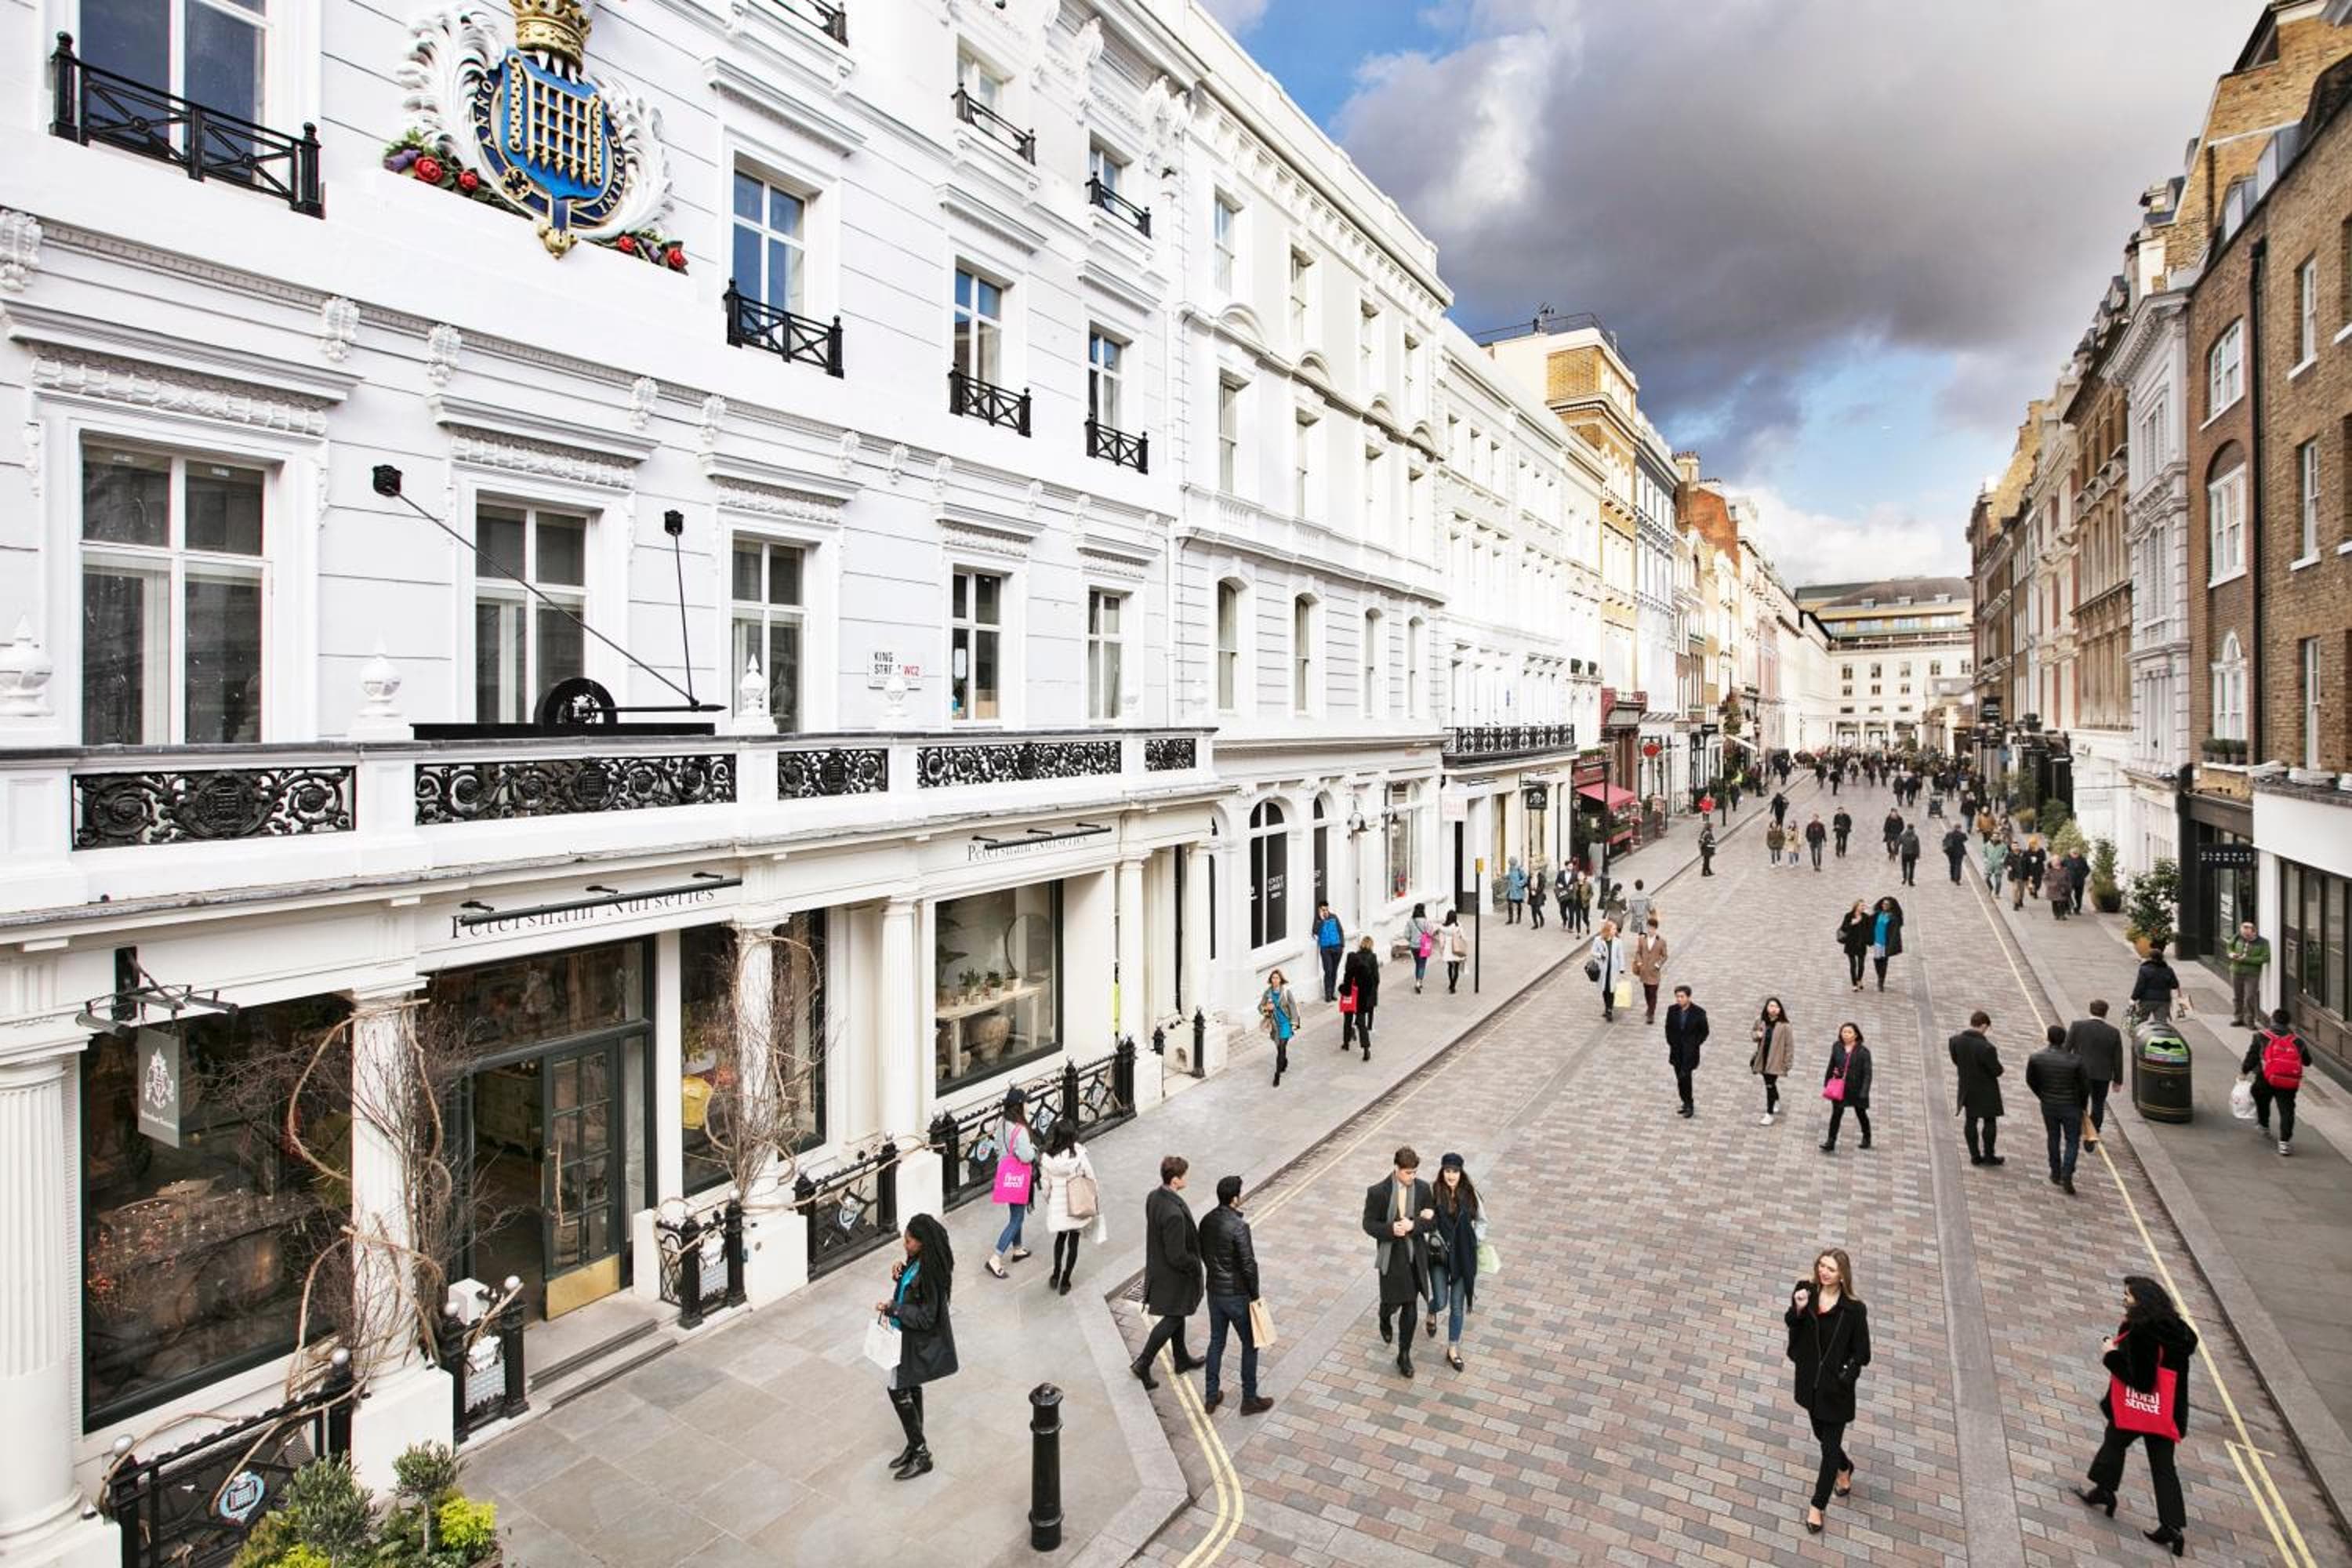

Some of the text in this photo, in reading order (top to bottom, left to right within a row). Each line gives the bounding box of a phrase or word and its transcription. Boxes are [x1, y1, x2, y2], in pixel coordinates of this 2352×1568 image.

[475, 79, 496, 151] ANNO
[597, 136, 626, 214] DOMINI
[874, 652, 894, 662] KING
[874, 664, 920, 677] STRET WC2
[2125, 1385, 2160, 1406] floral
[2125, 1398, 2161, 1415] street
